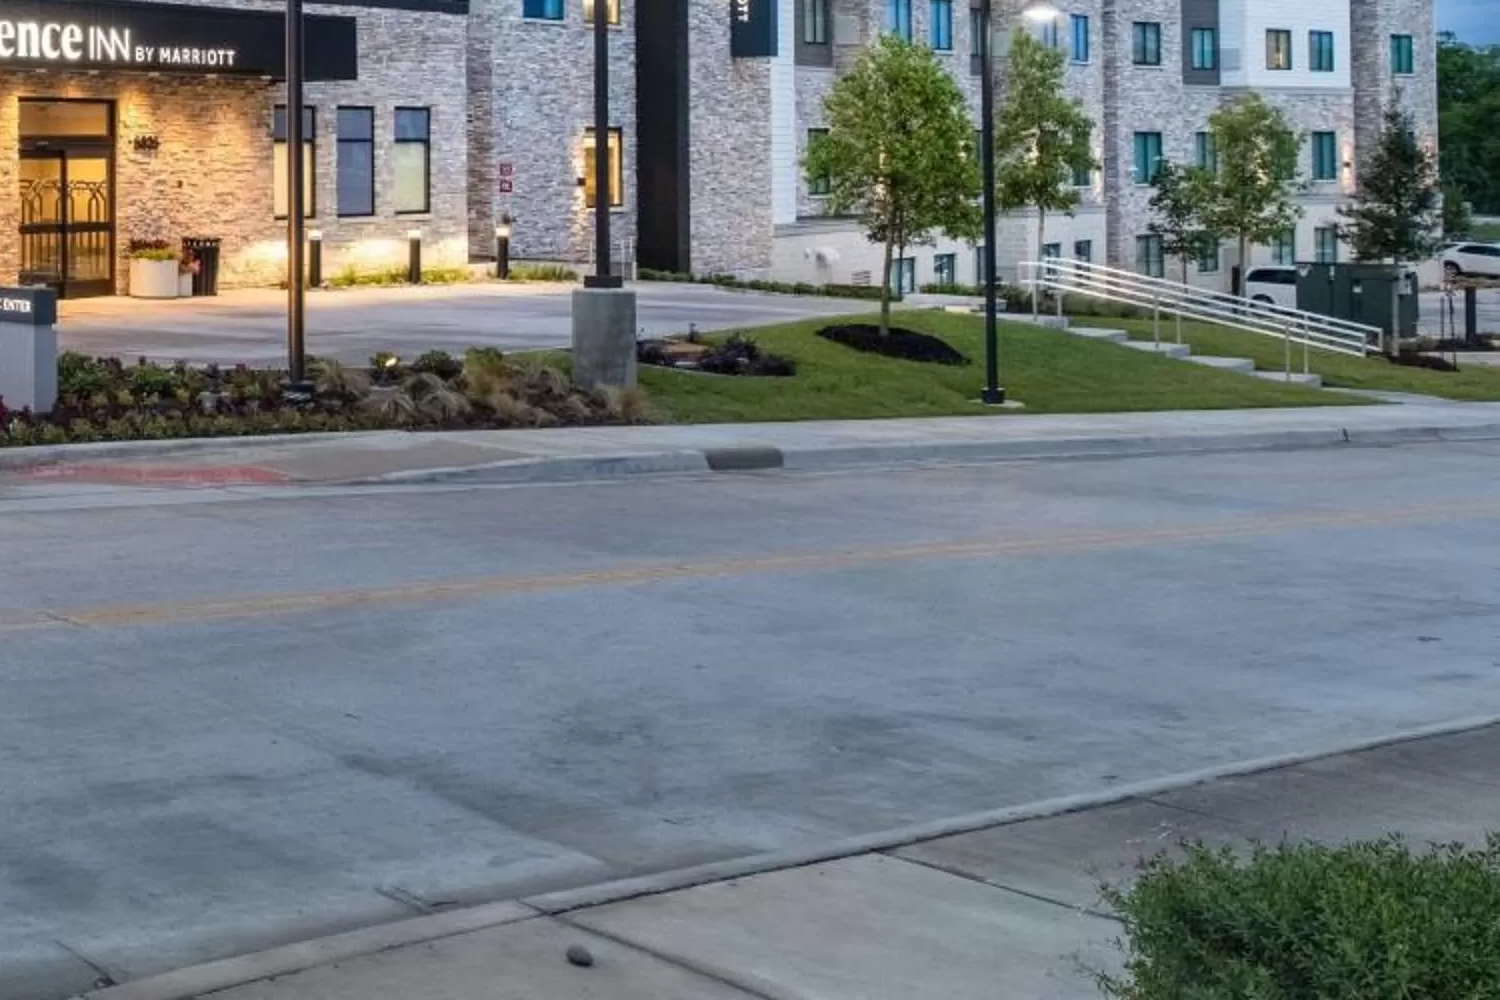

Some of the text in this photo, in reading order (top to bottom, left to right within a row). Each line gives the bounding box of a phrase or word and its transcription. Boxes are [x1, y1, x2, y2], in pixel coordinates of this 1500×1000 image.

[89, 25, 130, 62] INN
[135, 45, 154, 63] BY
[159, 46, 235, 66] MARRIOTT
